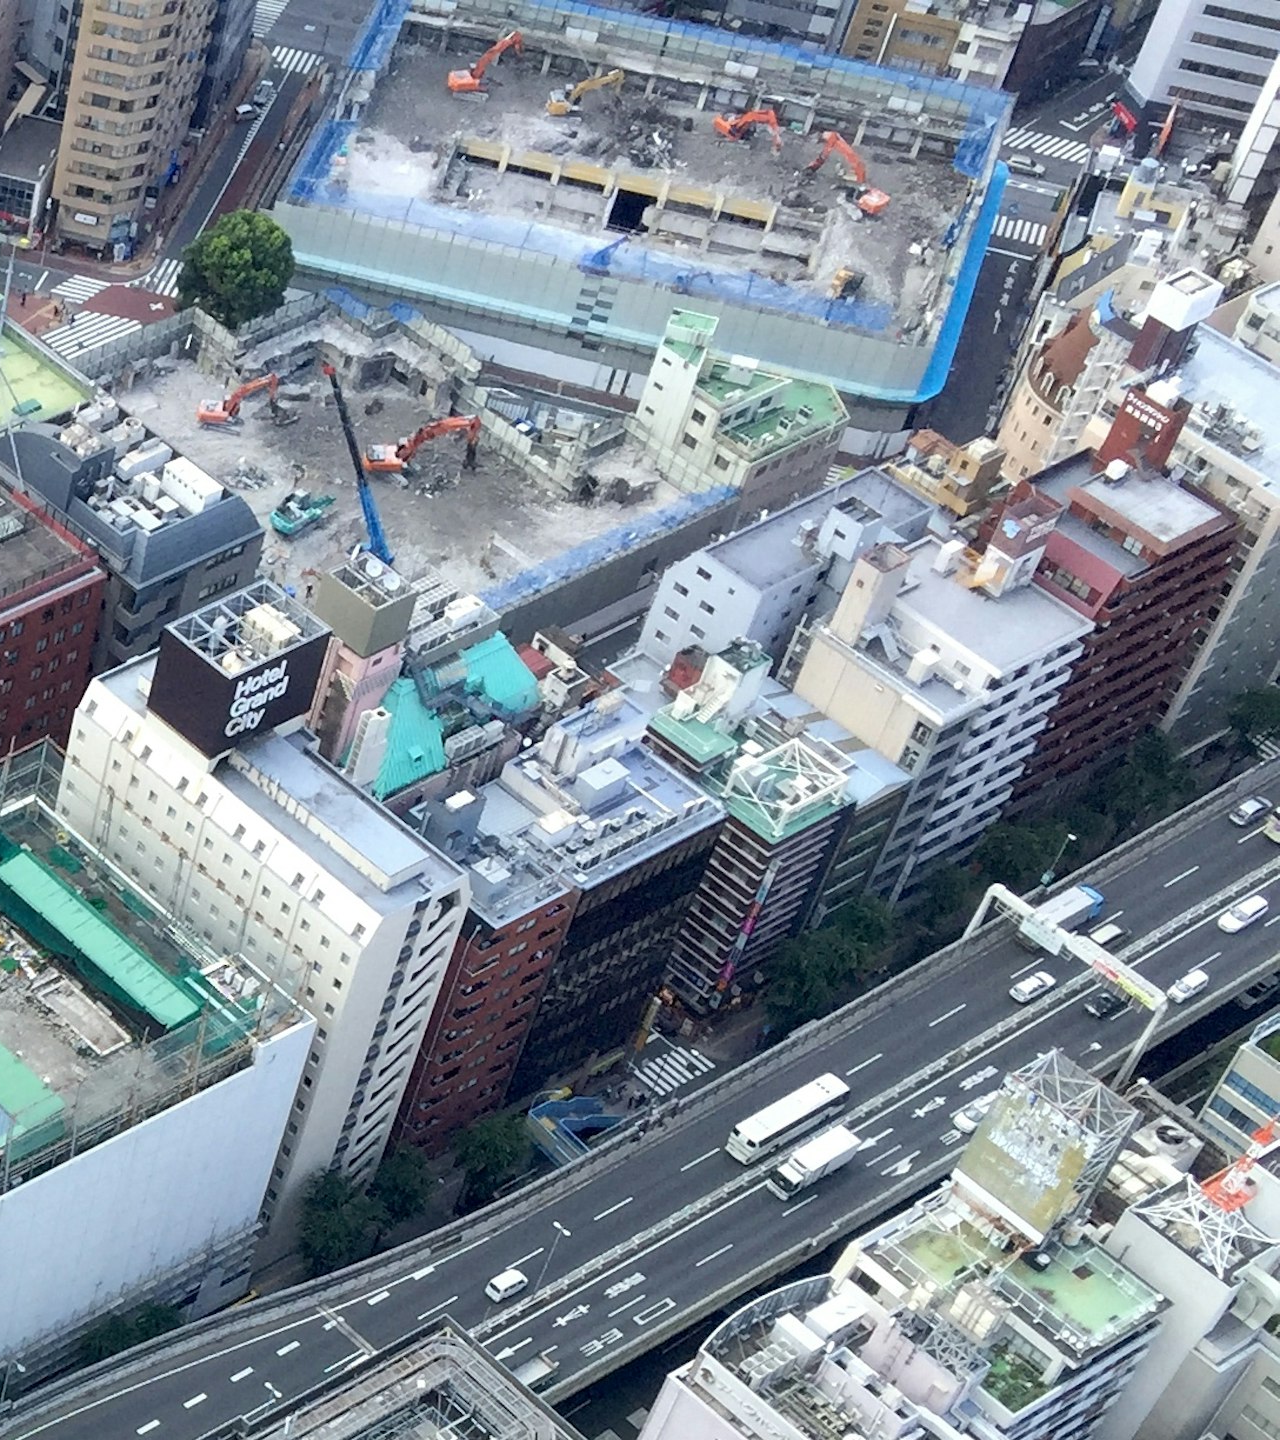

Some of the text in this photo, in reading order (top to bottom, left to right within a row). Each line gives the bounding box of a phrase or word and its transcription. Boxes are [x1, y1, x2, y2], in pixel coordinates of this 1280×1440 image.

[229, 675, 290, 718] Grand
[233, 659, 288, 701] Hotel
[224, 707, 266, 738] City
